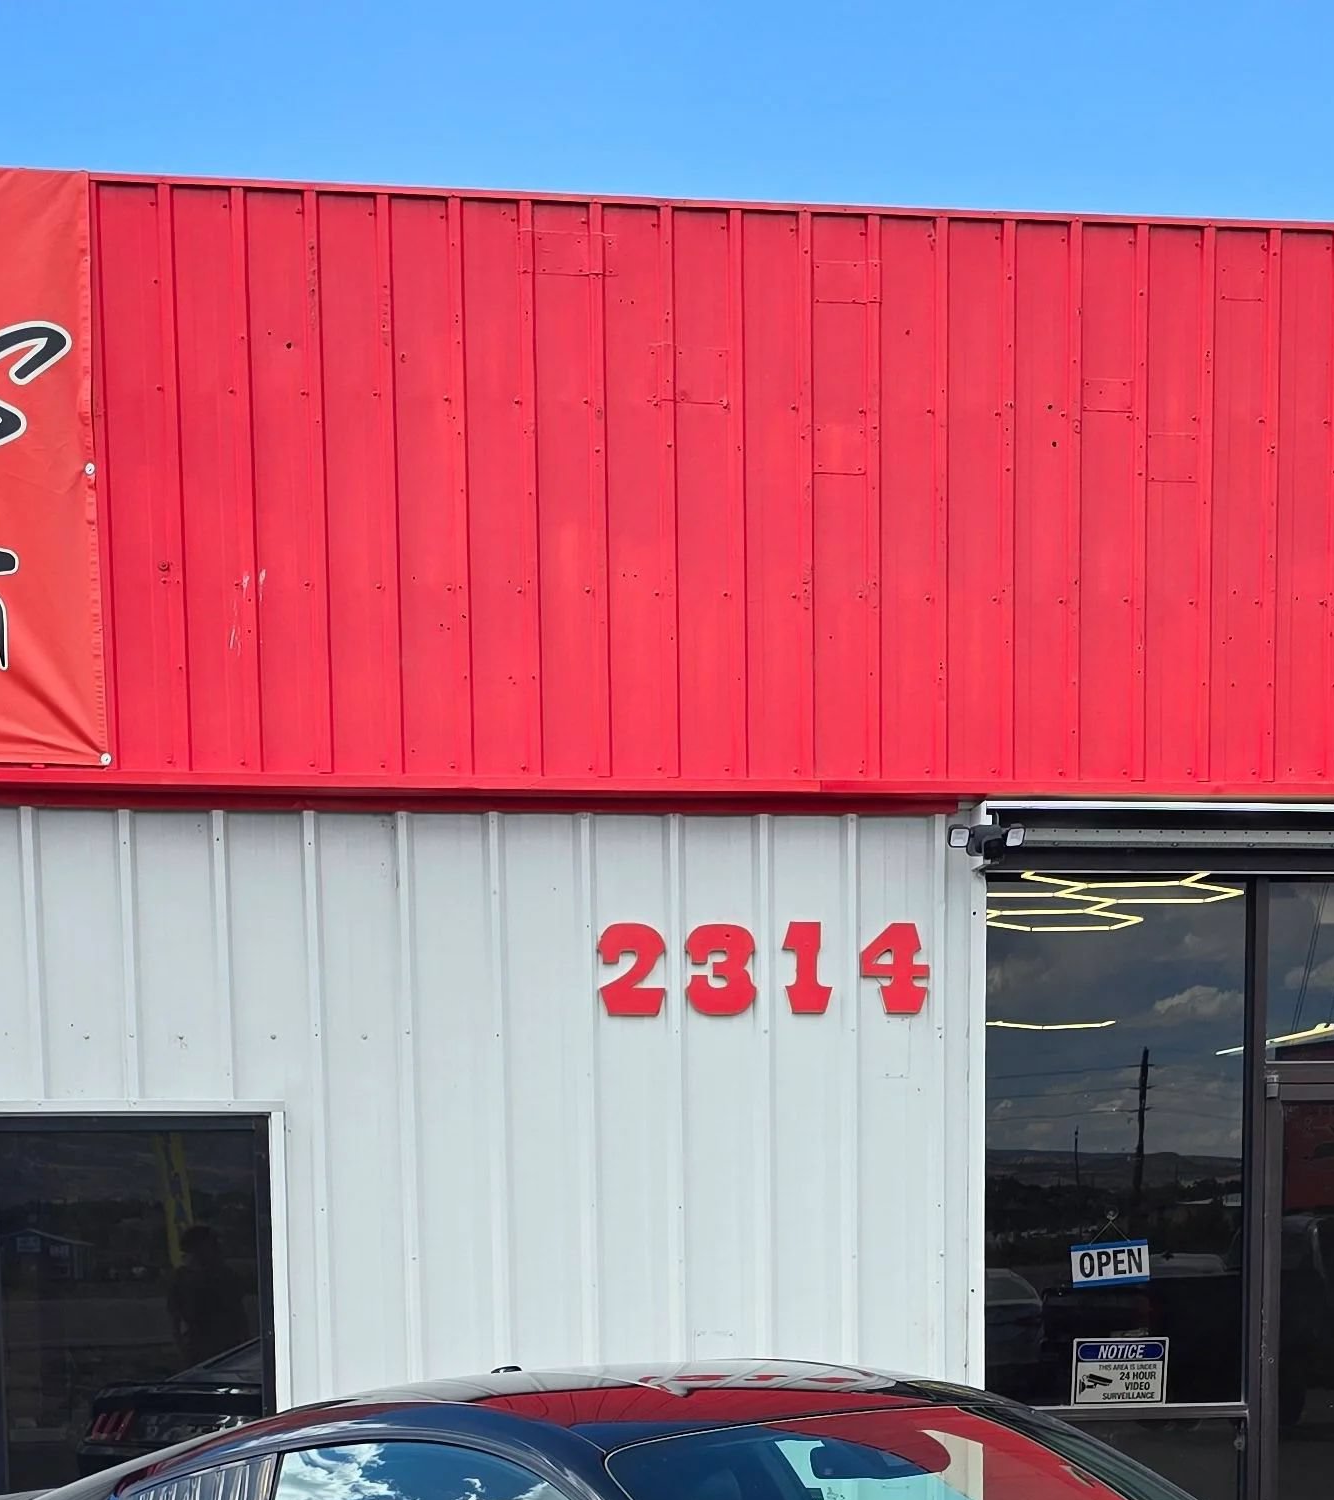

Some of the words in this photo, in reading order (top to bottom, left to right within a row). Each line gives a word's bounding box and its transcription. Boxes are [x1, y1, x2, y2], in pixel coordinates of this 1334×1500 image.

[596, 920, 931, 1017] 2314
[1079, 1247, 1143, 1279] OPEN
[1097, 1344, 1146, 1359] NOTICE
[1119, 1371, 1131, 1380] 24
[1132, 1370, 1157, 1380] HOUR
[1124, 1381, 1151, 1391] VIDEO
[1102, 1391, 1155, 1400] SURVEILLANCE
